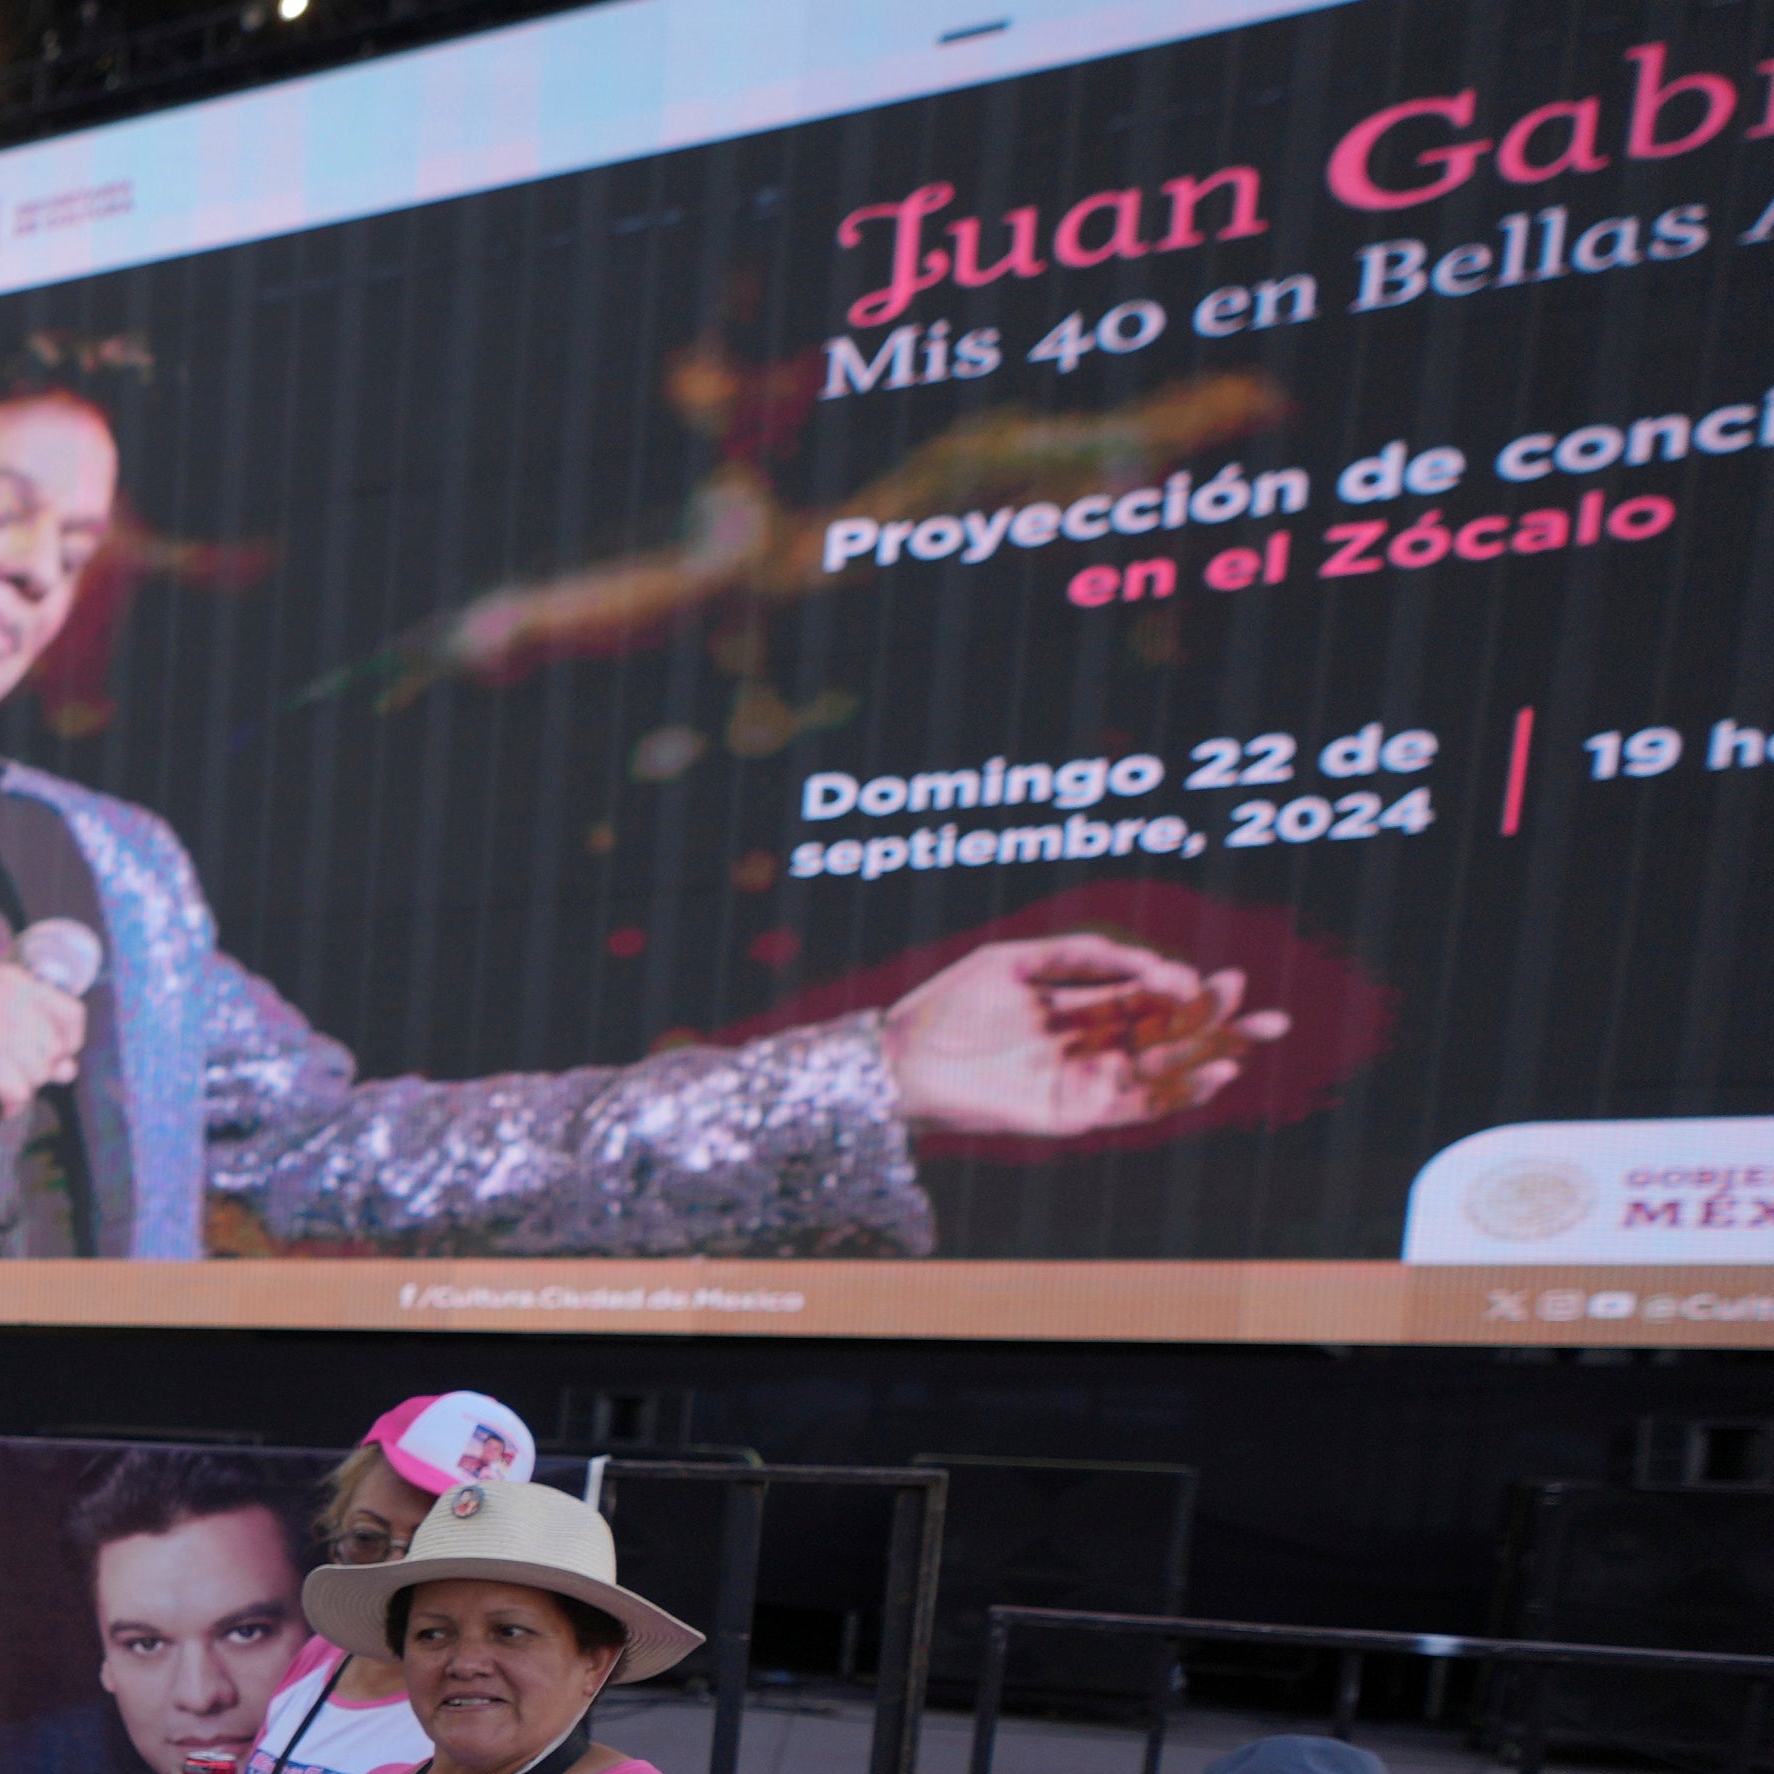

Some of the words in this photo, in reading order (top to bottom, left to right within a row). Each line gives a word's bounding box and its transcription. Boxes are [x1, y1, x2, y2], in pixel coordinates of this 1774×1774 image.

[820, 317, 1001, 399] Mis
[1029, 298, 1166, 374] 40
[1193, 272, 1317, 340] en
[1350, 201, 1710, 314] Bellas
[837, 164, 1268, 328] Juan
[822, 464, 1308, 574] Proyección
[1336, 438, 1465, 507] de
[1067, 553, 1176, 608] en
[1204, 531, 1288, 593] el
[1317, 488, 1677, 580] Zócalo
[802, 752, 1163, 824] Domingo
[1185, 731, 1296, 792] 22
[1319, 721, 1439, 780] de
[1582, 725, 1682, 780] 19
[789, 814, 1207, 881] septiembre,
[1227, 786, 1435, 852] 2024
